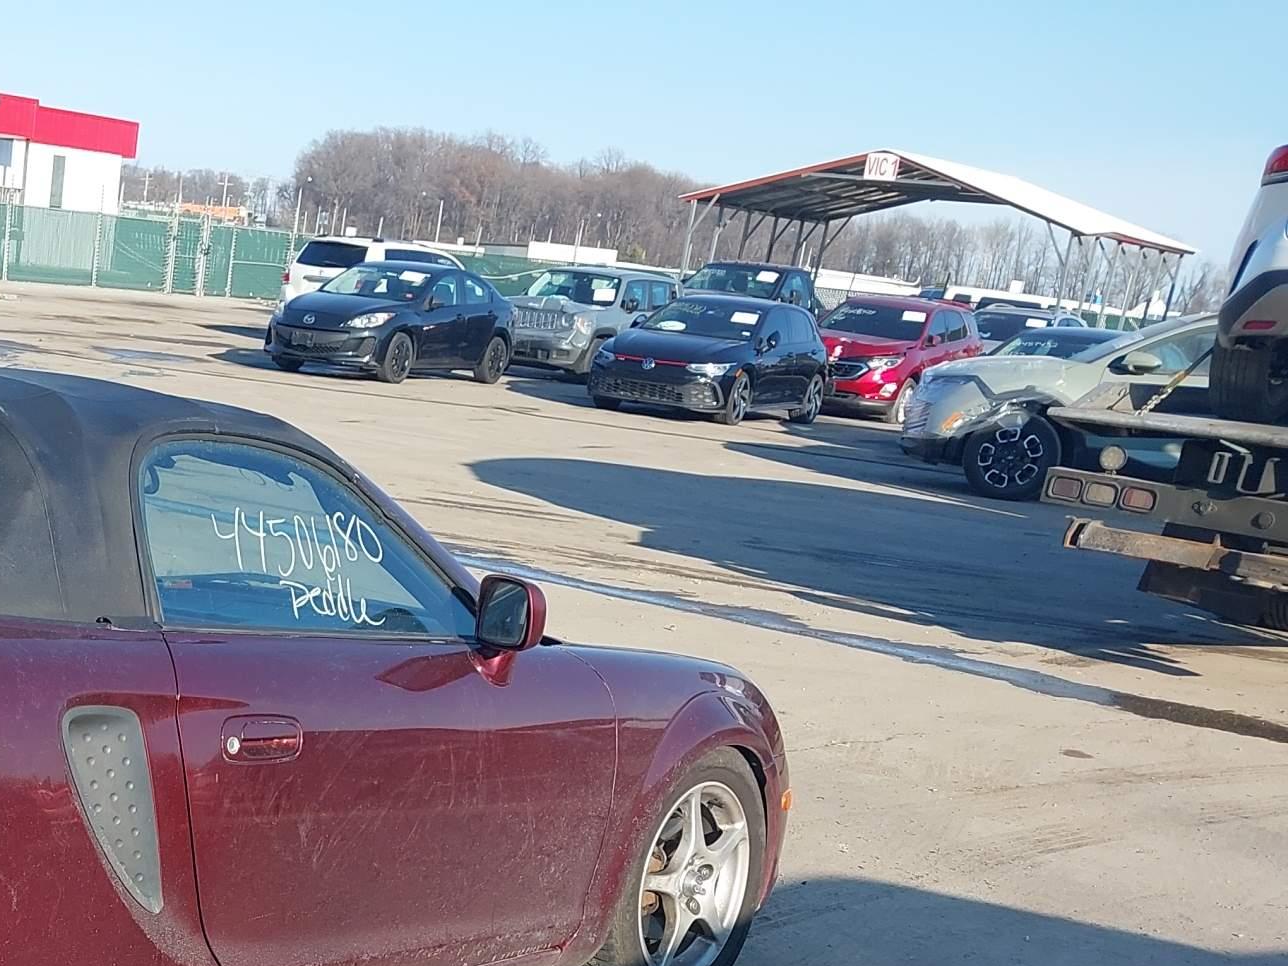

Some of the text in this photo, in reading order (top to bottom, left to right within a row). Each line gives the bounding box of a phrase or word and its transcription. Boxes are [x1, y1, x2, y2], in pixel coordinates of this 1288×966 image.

[868, 157, 899, 177] VIC 1
[210, 506, 383, 577] 44506180
[279, 573, 386, 626] Peddle
